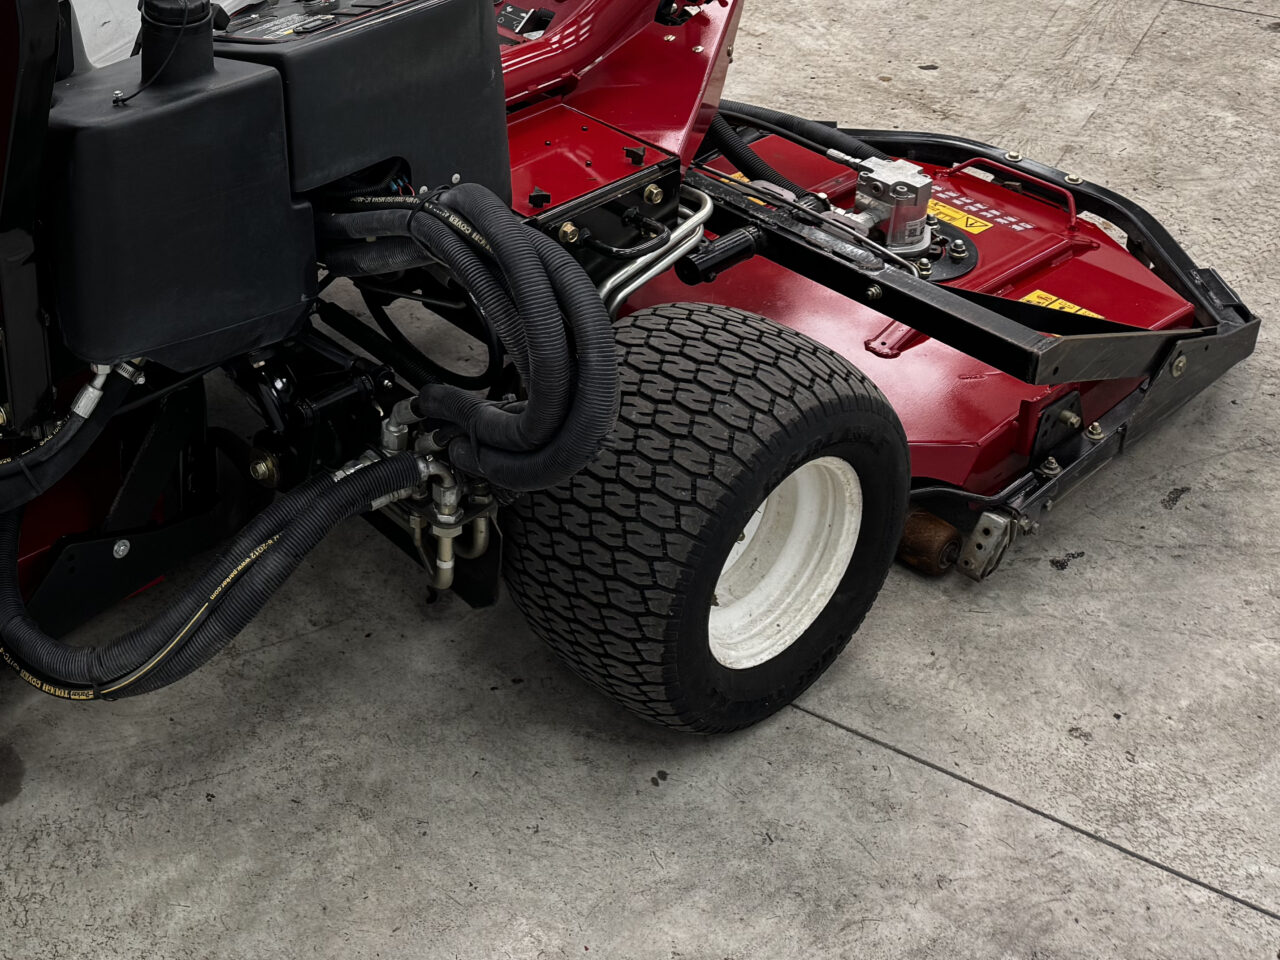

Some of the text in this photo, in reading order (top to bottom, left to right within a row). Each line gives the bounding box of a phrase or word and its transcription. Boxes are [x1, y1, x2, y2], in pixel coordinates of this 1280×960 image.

[449, 214, 472, 234] COVER
[209, 557, 251, 599] www.parker.com
[41, 683, 70, 698] TOUGH
